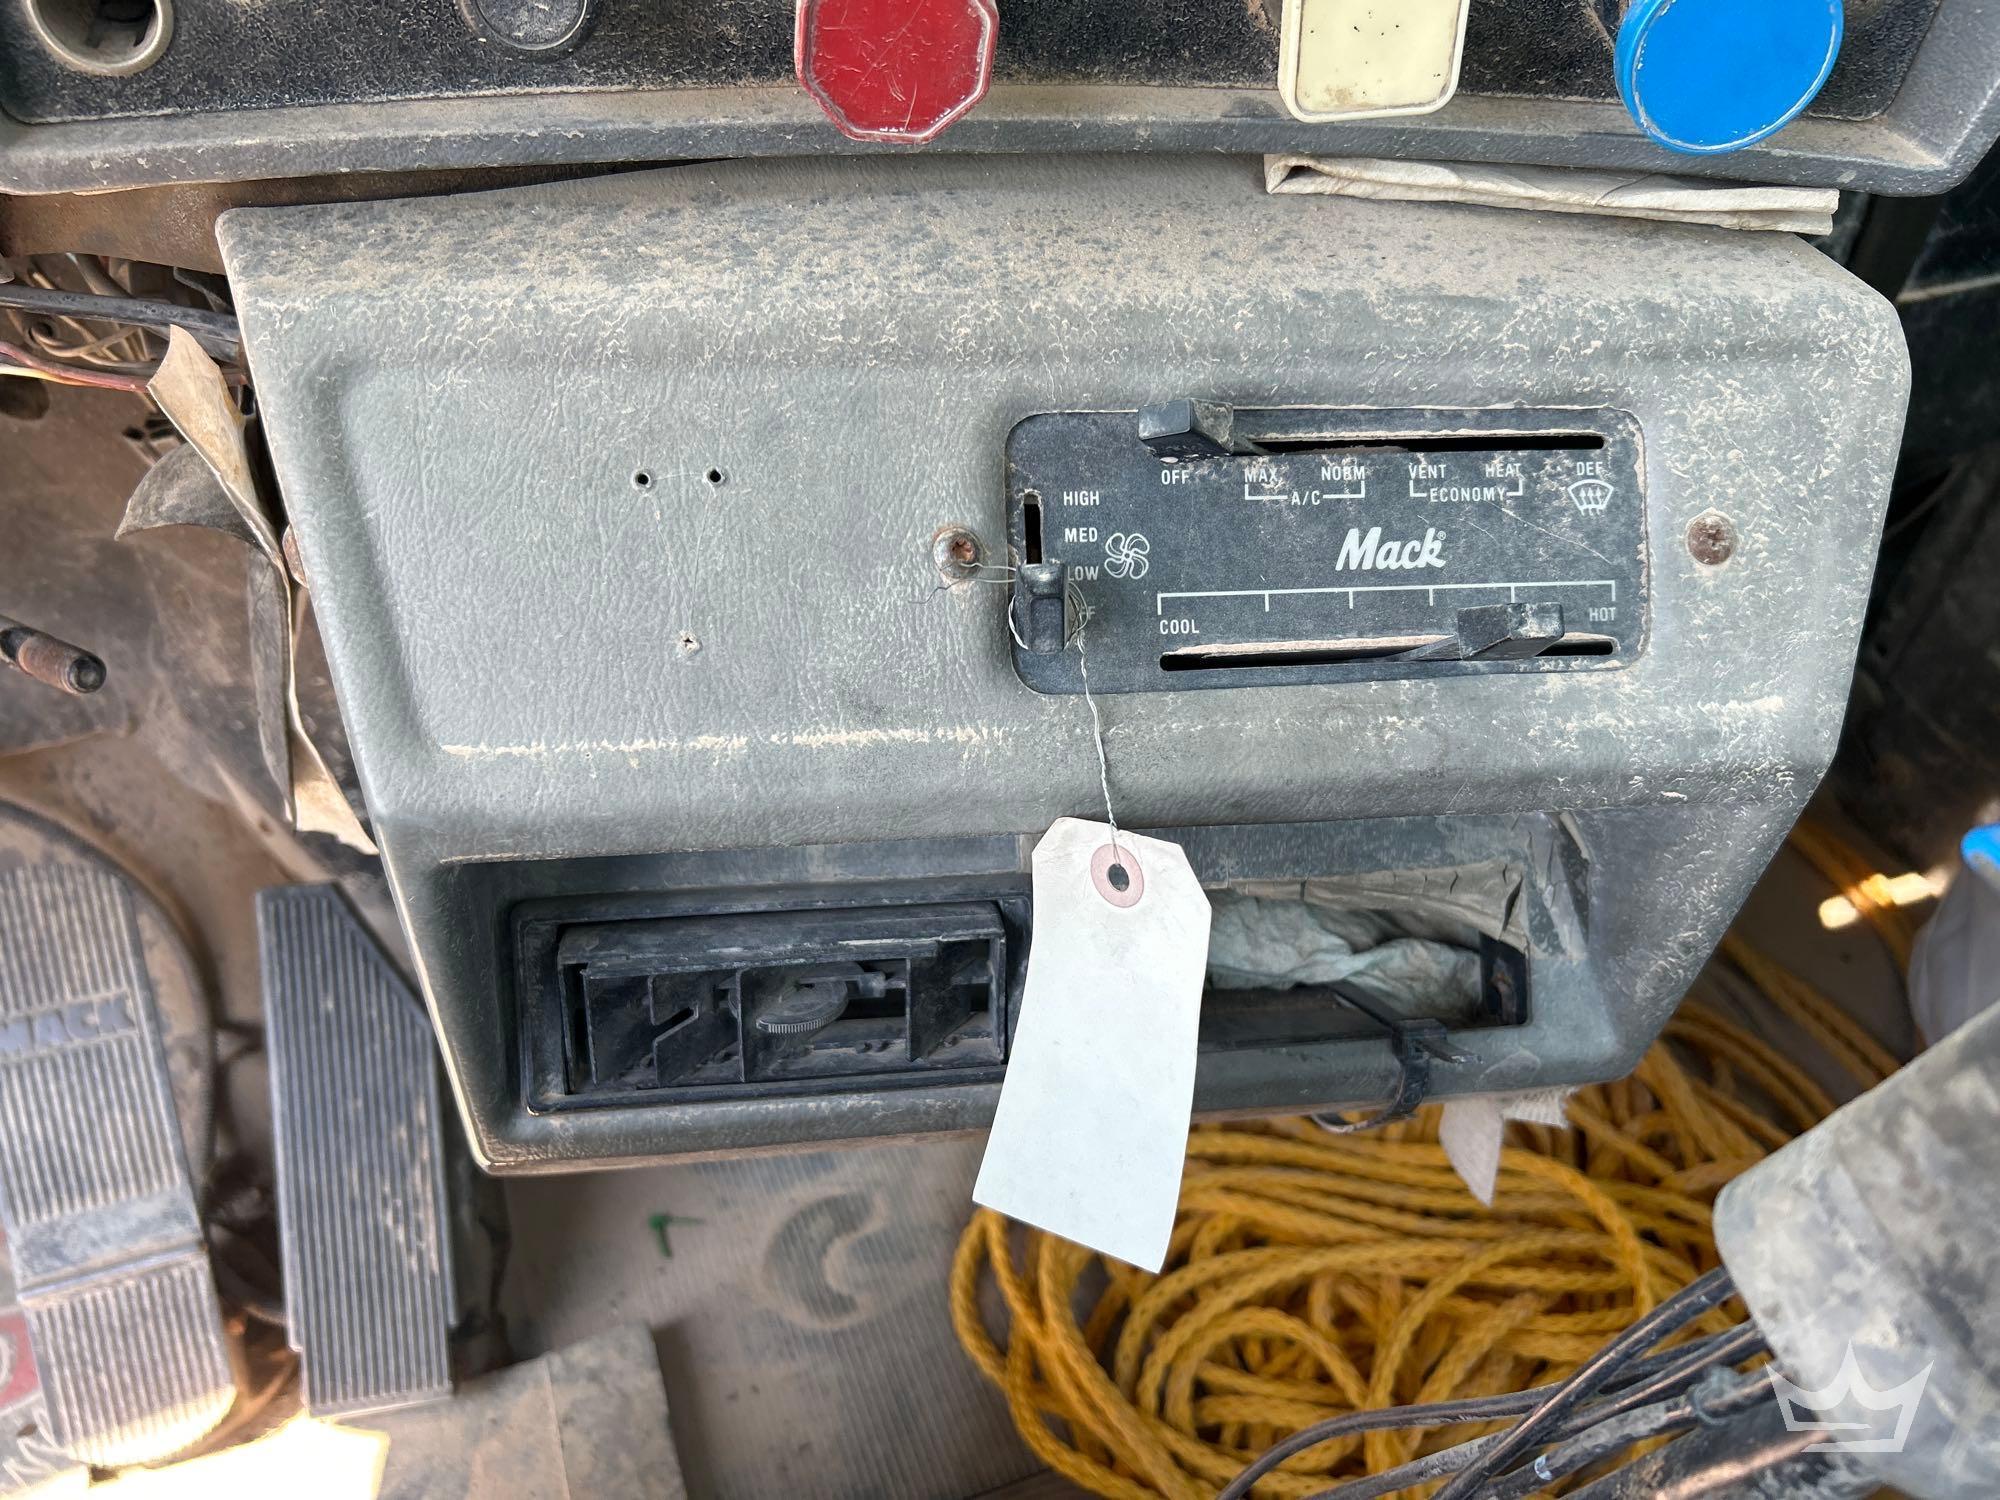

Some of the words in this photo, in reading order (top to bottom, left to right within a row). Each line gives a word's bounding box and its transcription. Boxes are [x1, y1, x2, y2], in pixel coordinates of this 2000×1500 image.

[1244, 467, 1277, 483] MAX
[1321, 466, 1365, 481] NORM
[1408, 464, 1446, 480] VENT
[1485, 464, 1522, 478] HEAT
[1576, 461, 1602, 476] DEF
[1161, 470, 1190, 485] OFF
[1063, 490, 1100, 506] HIGH
[1291, 490, 1320, 506] A/C
[1430, 487, 1507, 502] ECONOMY
[1064, 528, 1098, 543] MED
[1067, 565, 1099, 581] LOW
[1588, 606, 1617, 621] HOT
[1159, 619, 1200, 635] COOL
